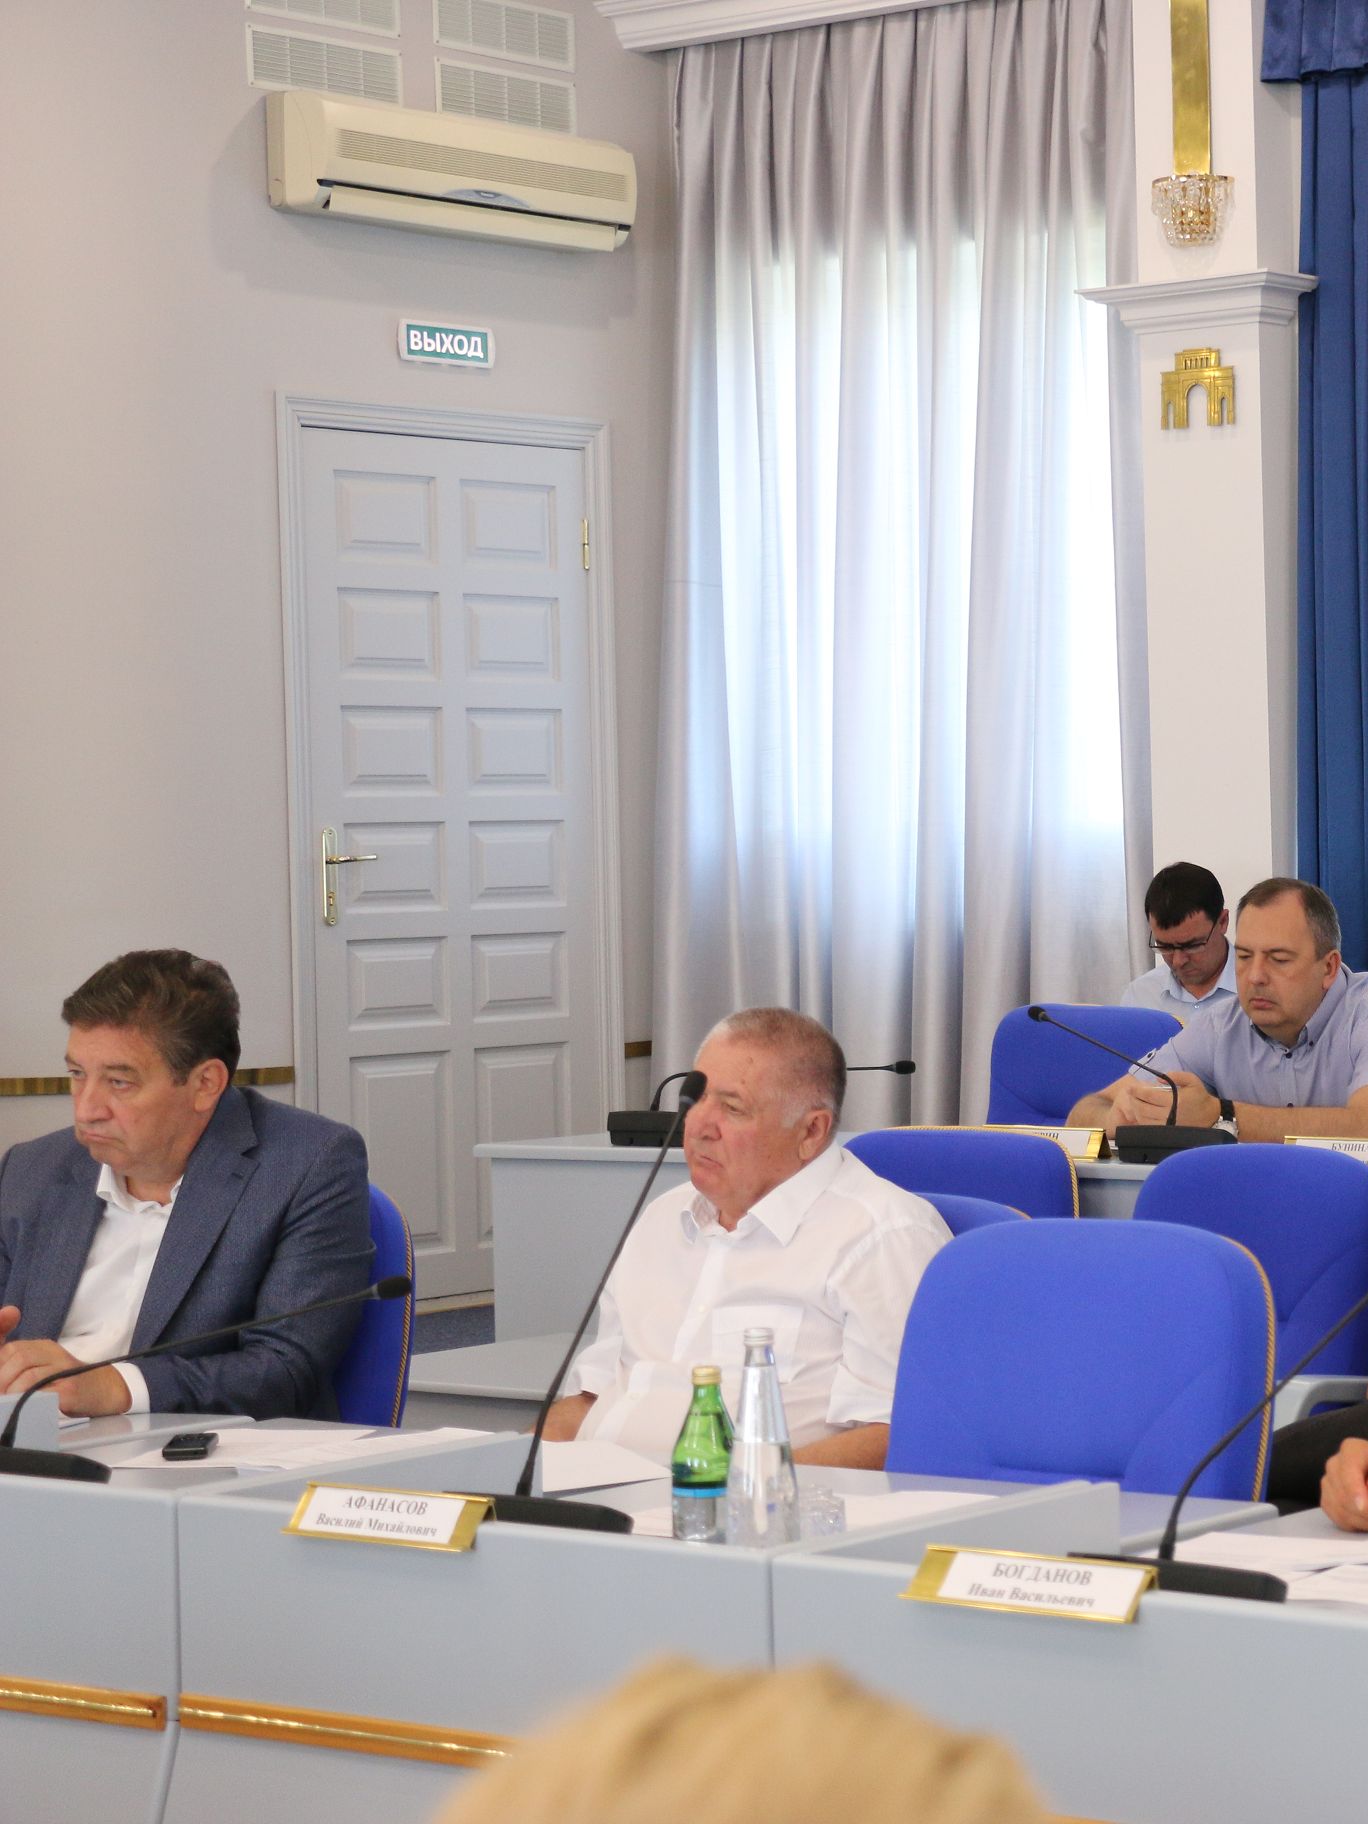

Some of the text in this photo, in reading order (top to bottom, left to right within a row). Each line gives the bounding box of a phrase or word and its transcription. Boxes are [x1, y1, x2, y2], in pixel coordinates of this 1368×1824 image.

[410, 330, 484, 358] ВЫХОД
[342, 1495, 429, 1516] АФАНАСОВ
[315, 1512, 438, 1538] Василий Михайлович
[992, 1562, 1094, 1586] БОГДАНОВ
[968, 1582, 1097, 1608] Иван Васильевич
